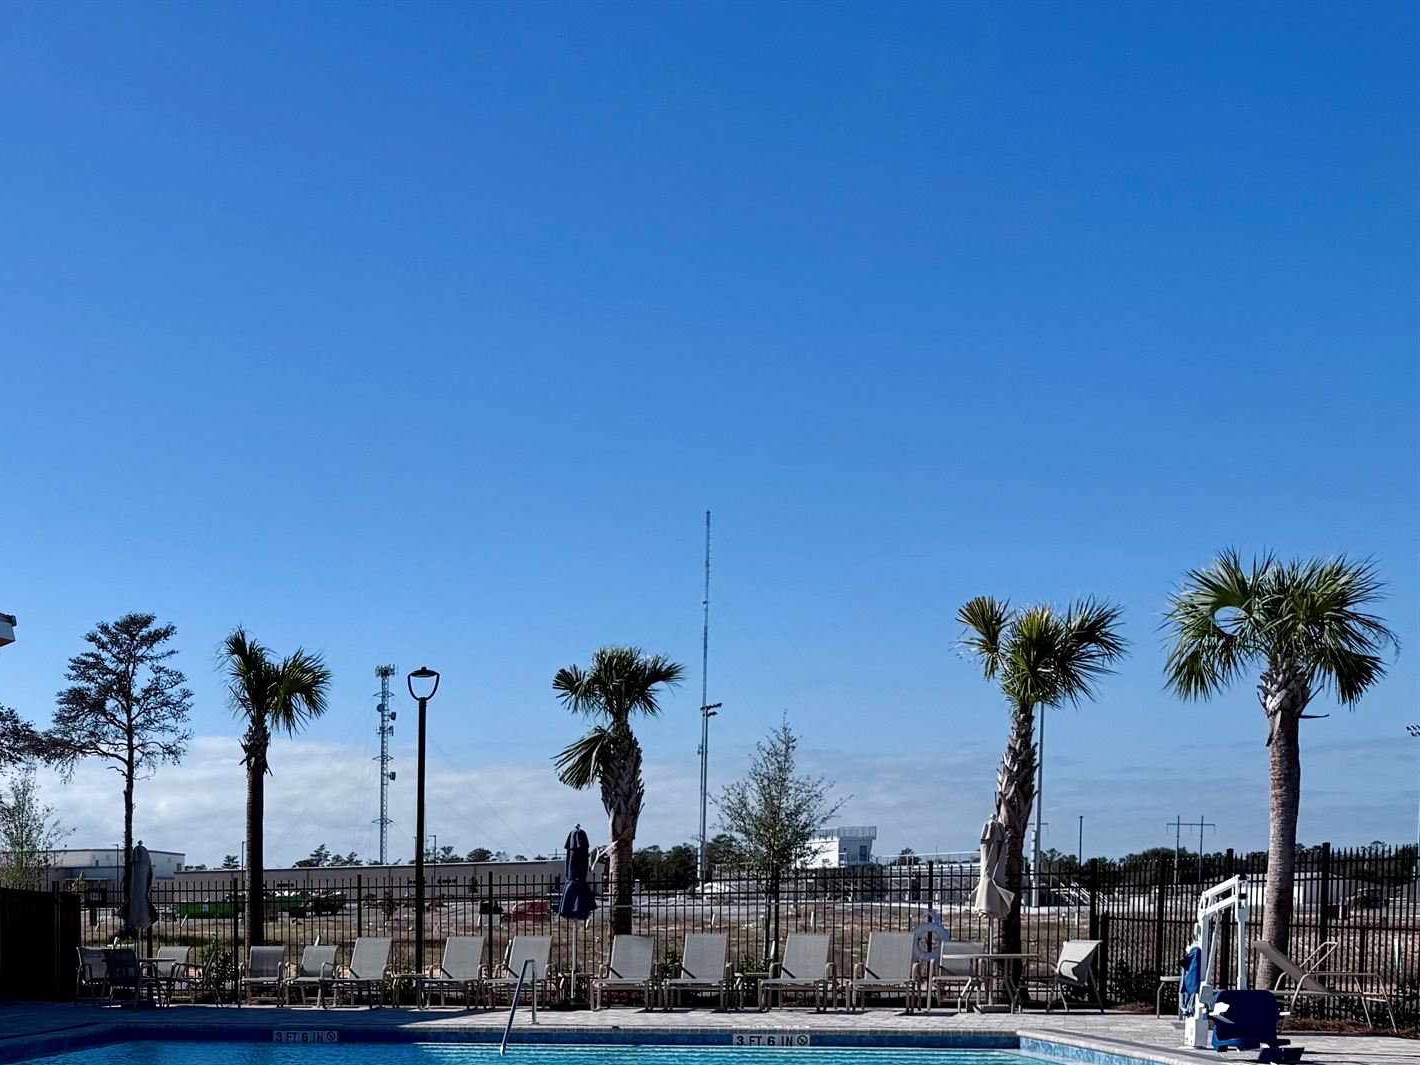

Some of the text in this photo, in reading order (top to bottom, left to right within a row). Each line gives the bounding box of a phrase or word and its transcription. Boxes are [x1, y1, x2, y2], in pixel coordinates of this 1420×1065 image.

[286, 1032, 298, 1042] FT
[313, 1032, 323, 1042] IN
[736, 1035, 793, 1046] 3 FT 6 IN
